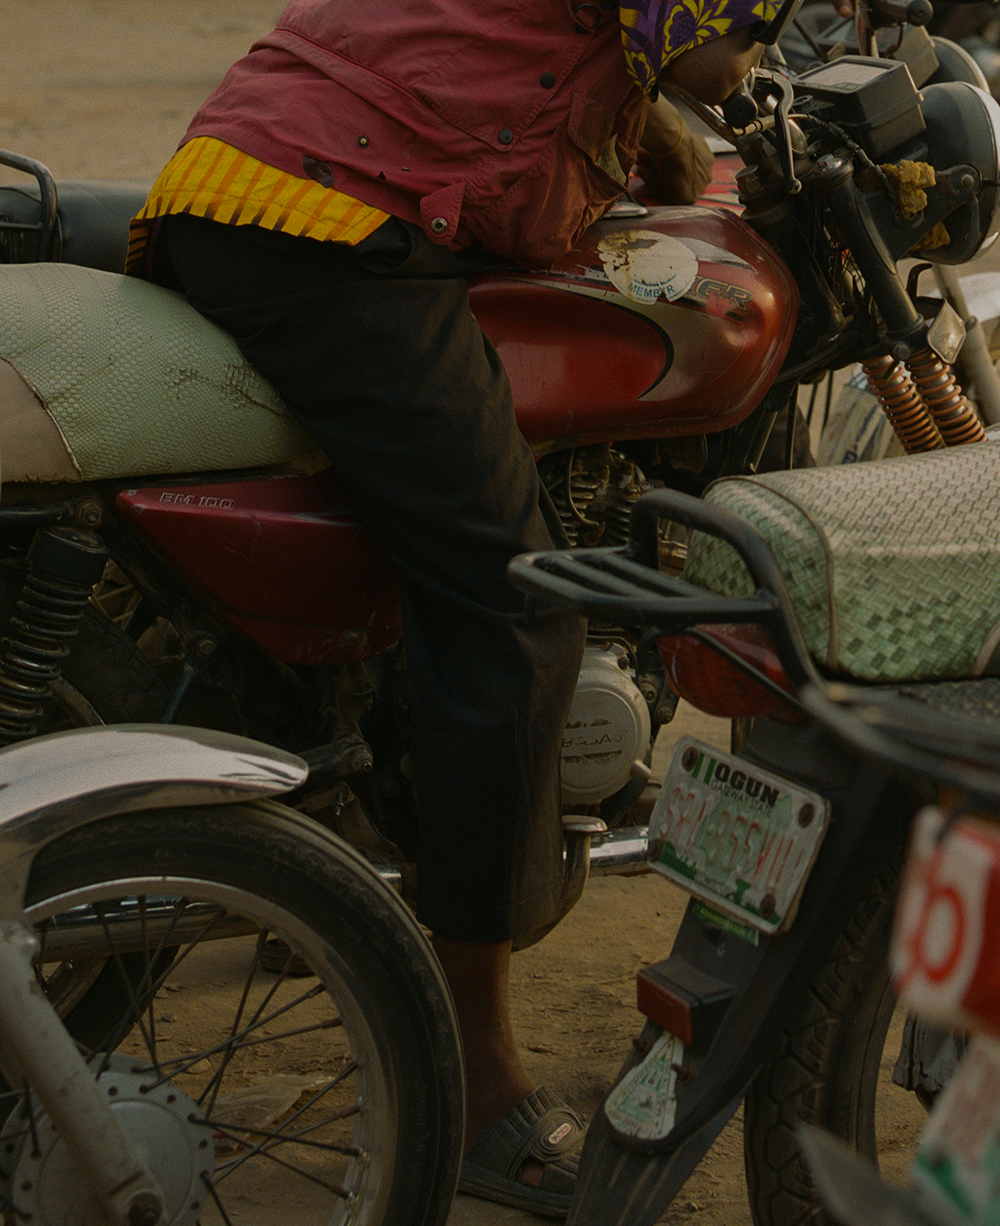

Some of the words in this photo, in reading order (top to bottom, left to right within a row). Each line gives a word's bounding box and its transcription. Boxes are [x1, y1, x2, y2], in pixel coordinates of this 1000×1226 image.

[628, 281, 676, 298] MEMBR
[197, 496, 236, 511] 100
[714, 763, 780, 806] OGUN
